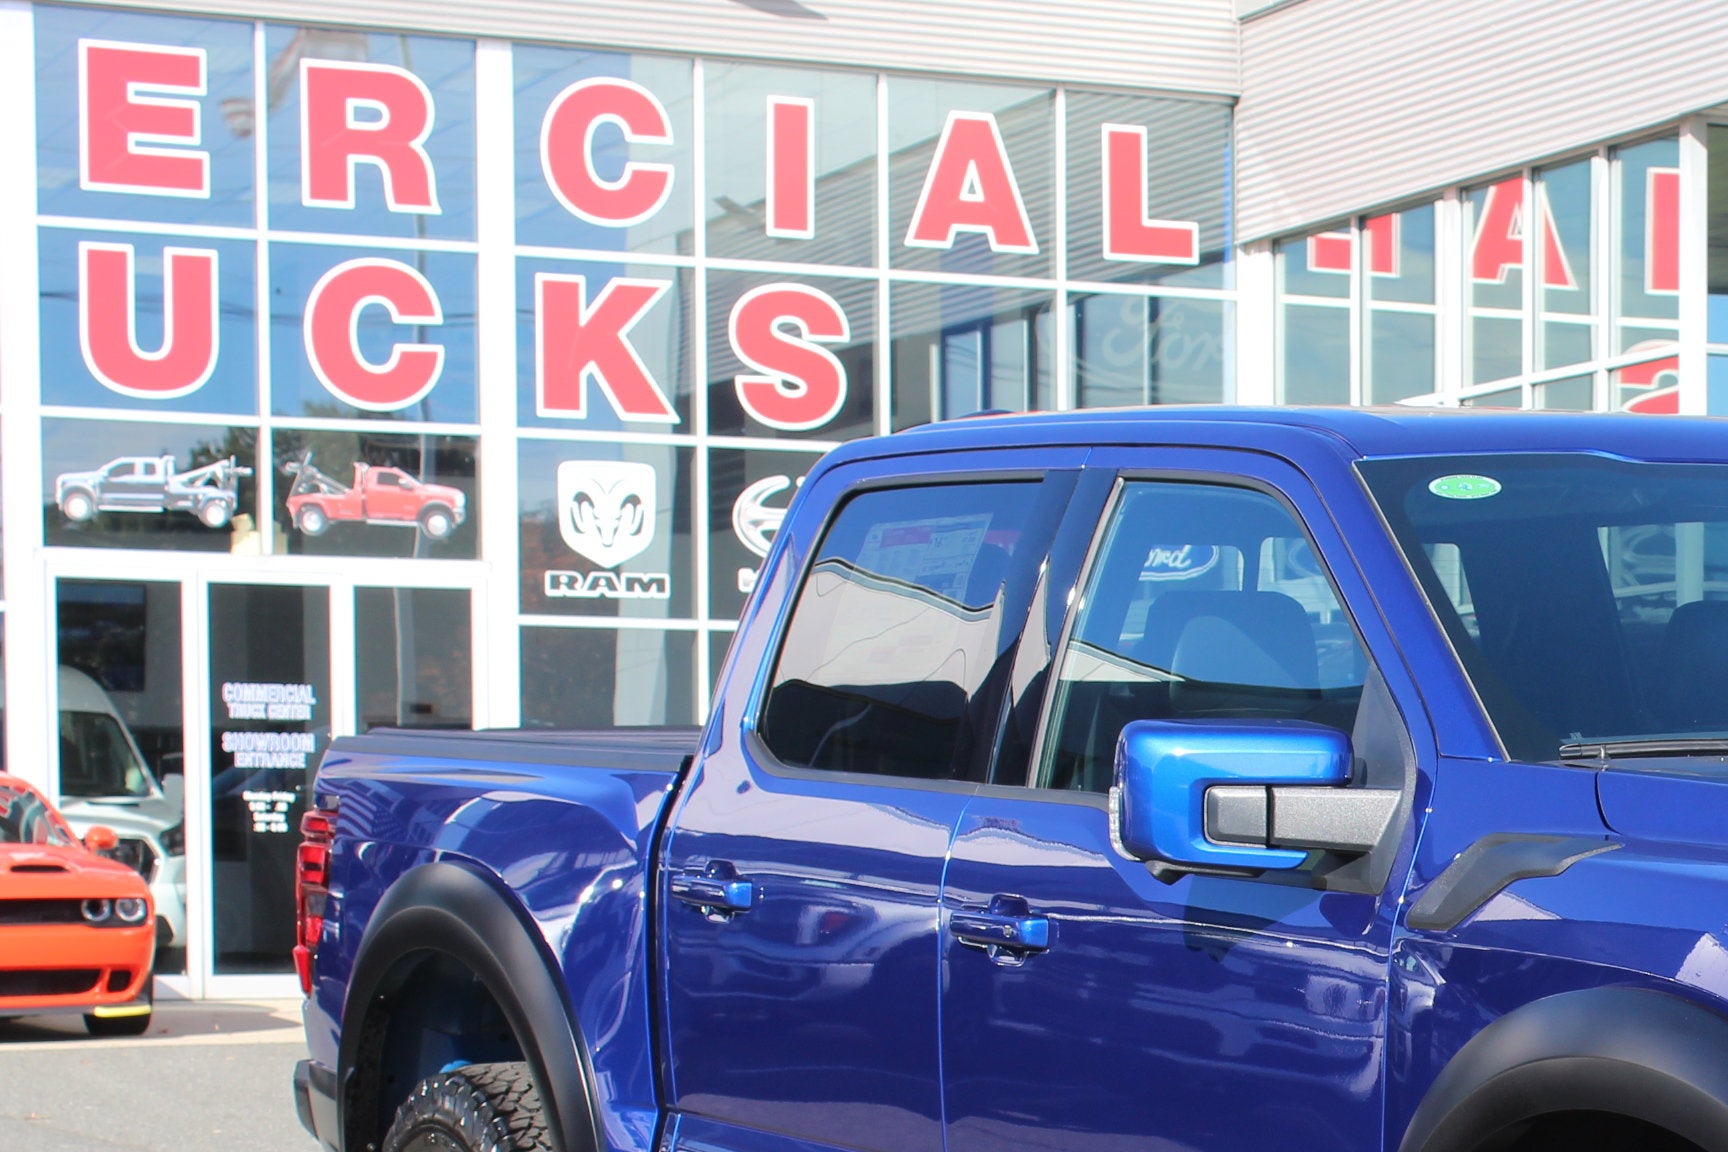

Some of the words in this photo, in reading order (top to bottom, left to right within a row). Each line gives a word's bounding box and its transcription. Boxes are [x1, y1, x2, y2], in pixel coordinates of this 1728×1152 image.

[78, 38, 1200, 265] ERCIAL
[78, 241, 851, 431] UCKS
[545, 570, 670, 599] RAM
[222, 683, 316, 705] COMMERCIAL
[222, 732, 315, 753] SHOWROOM
[234, 752, 306, 768] ENTRANCE
